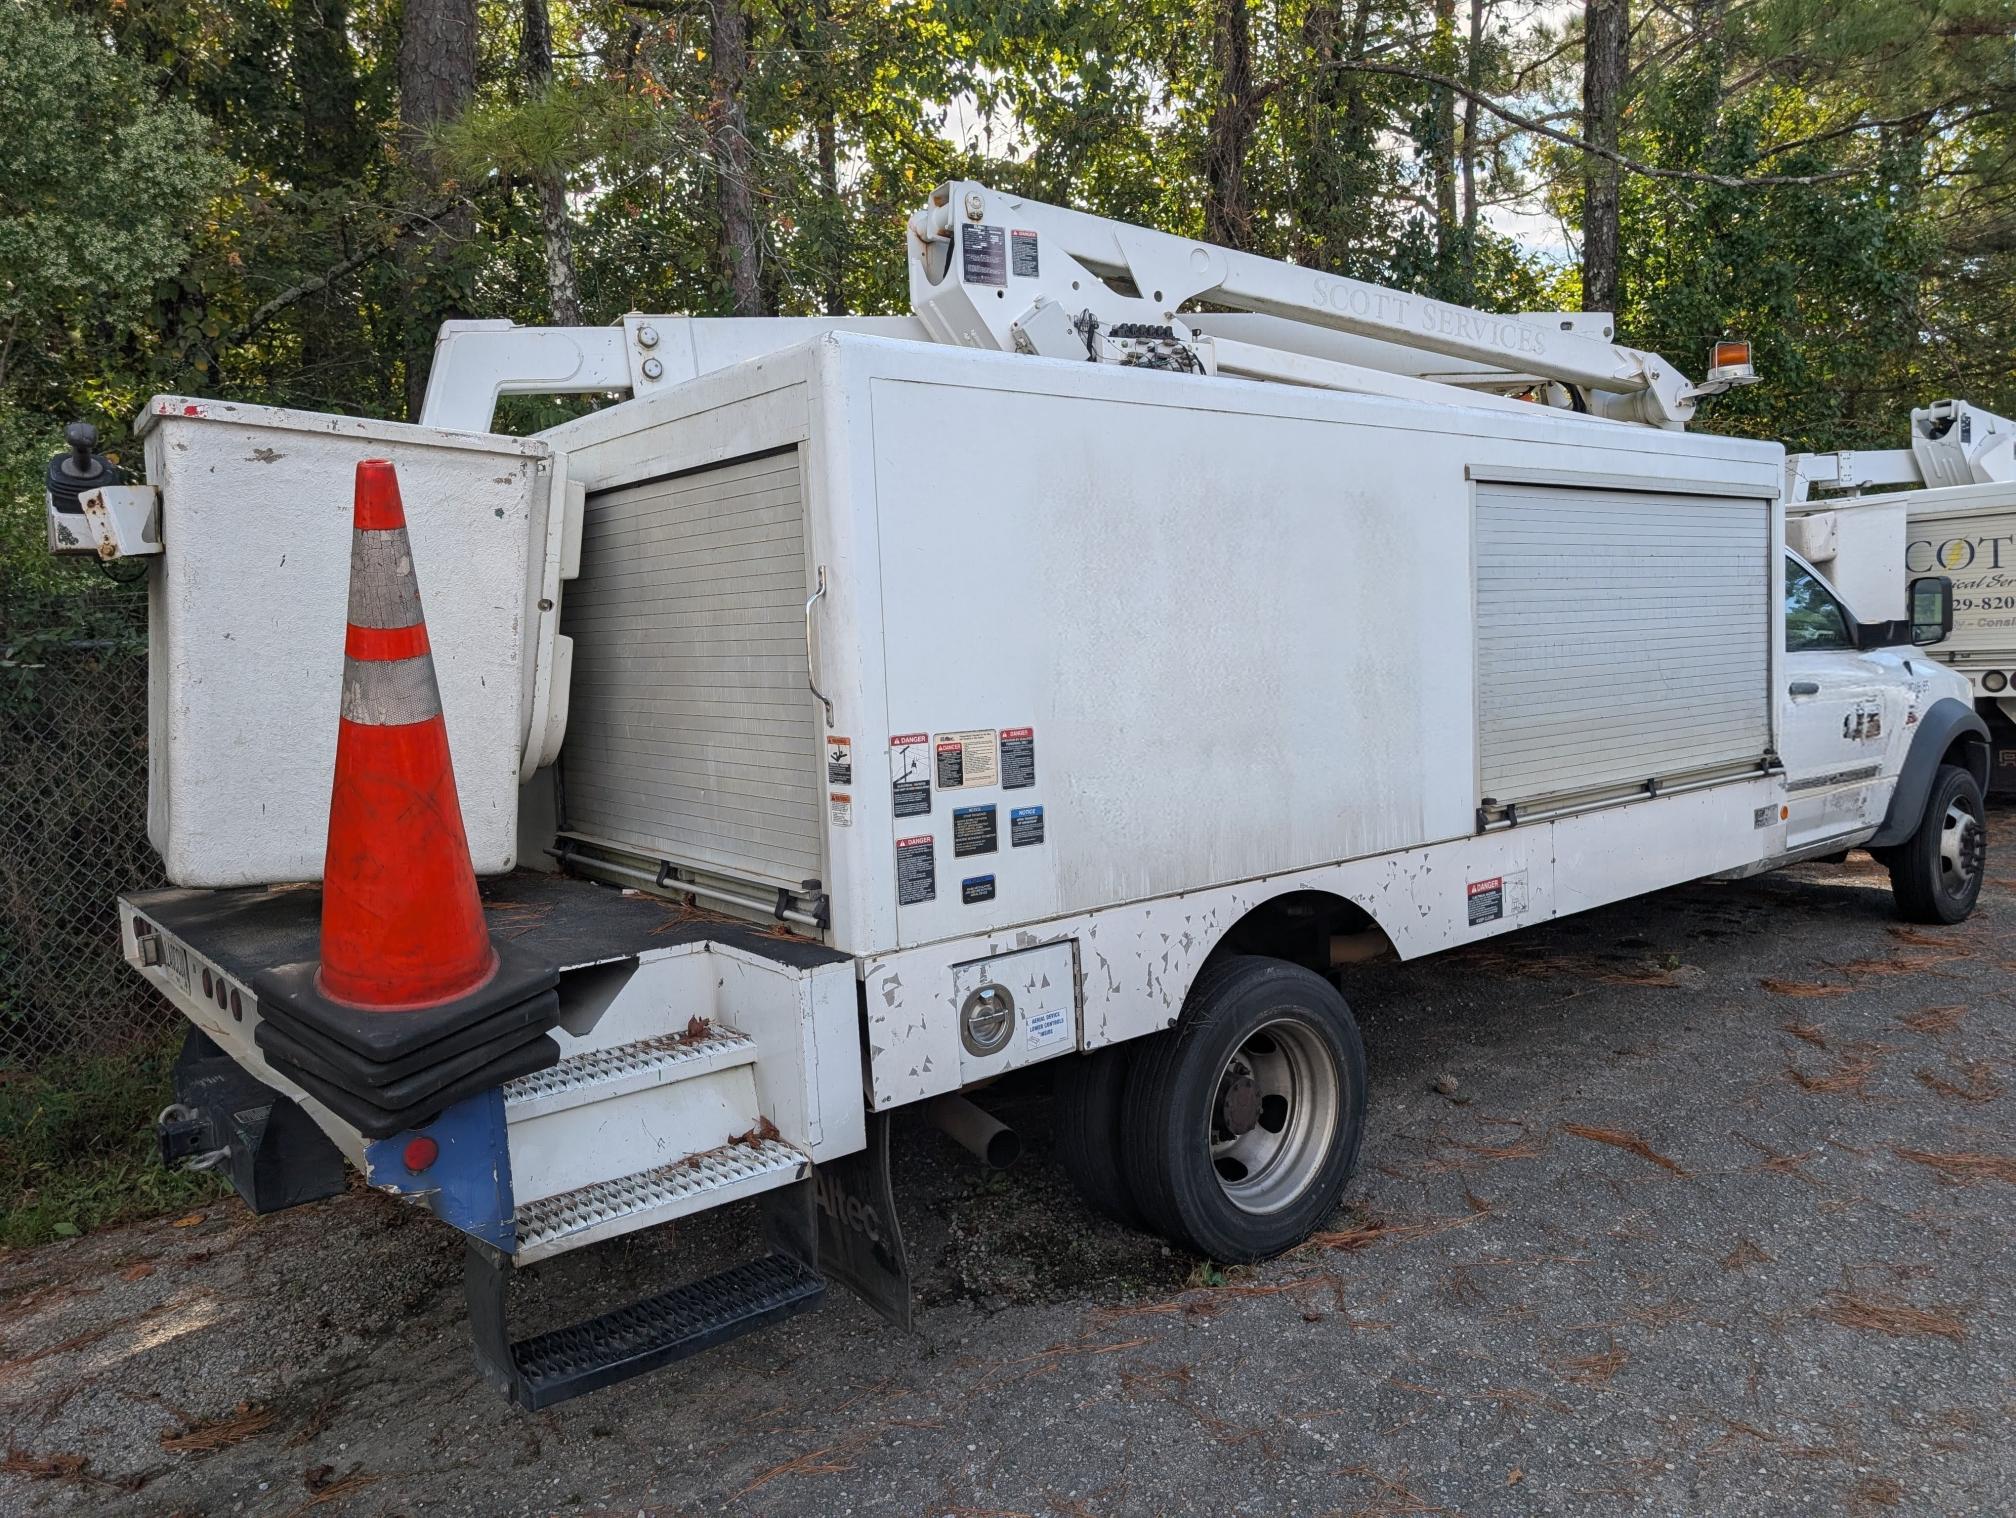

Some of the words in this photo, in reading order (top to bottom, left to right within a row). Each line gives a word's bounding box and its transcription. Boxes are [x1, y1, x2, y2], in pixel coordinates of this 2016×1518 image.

[1312, 277, 1410, 324] SCOTT
[1422, 302, 1546, 355] SERVICES
[1906, 534, 2013, 573] COT
[1952, 576, 1987, 590] ical
[1986, 574, 2016, 588] Ser
[1952, 597, 2015, 611] 29-820
[901, 735, 926, 744] DANGER
[942, 743, 961, 751] DANGER
[907, 836, 931, 846] DANGER
[1477, 880, 1499, 891] DANGER
[1046, 1012, 1060, 1020] DEVICE
[813, 1170, 881, 1241] Altec
